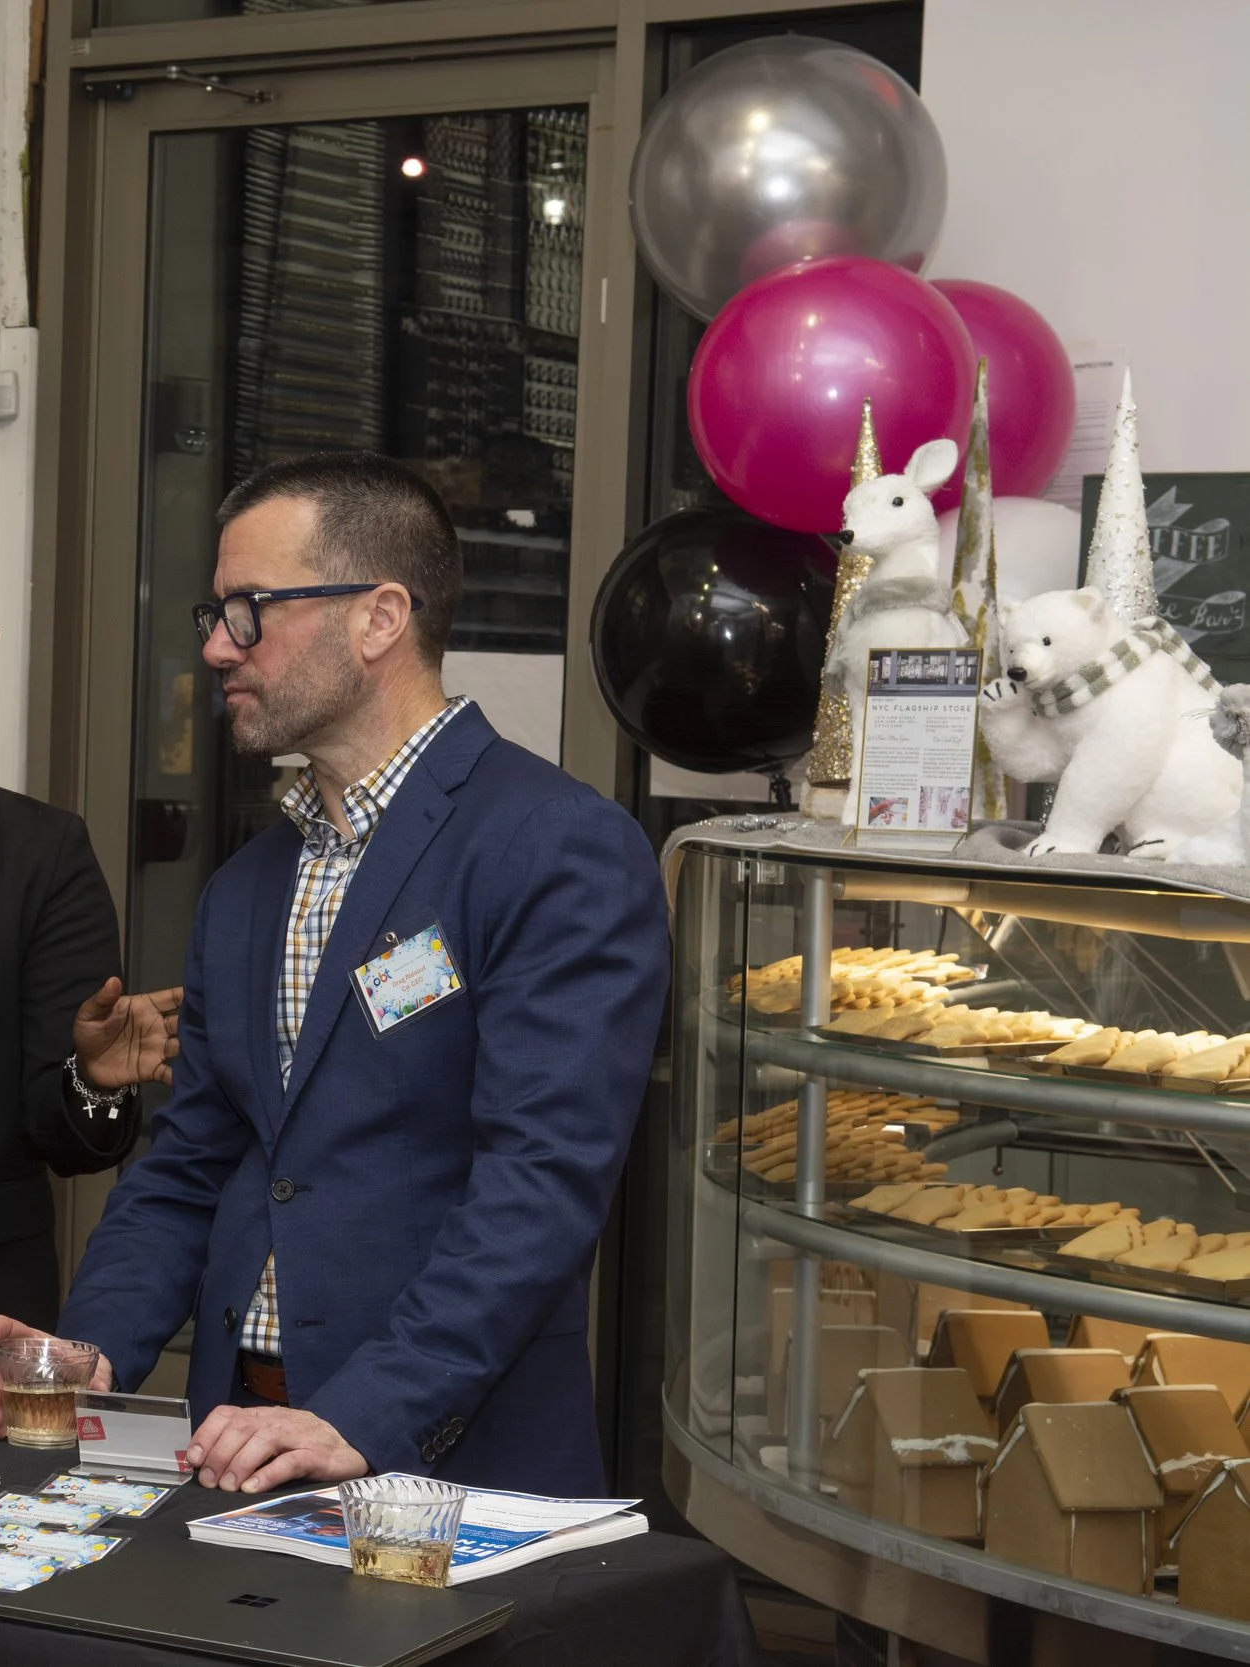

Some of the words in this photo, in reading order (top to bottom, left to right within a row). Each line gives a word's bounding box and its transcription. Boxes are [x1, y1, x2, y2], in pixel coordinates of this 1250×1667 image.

[871, 704, 889, 712] NYC
[893, 704, 939, 712] FLAGSHIP
[373, 968, 392, 987] obt
